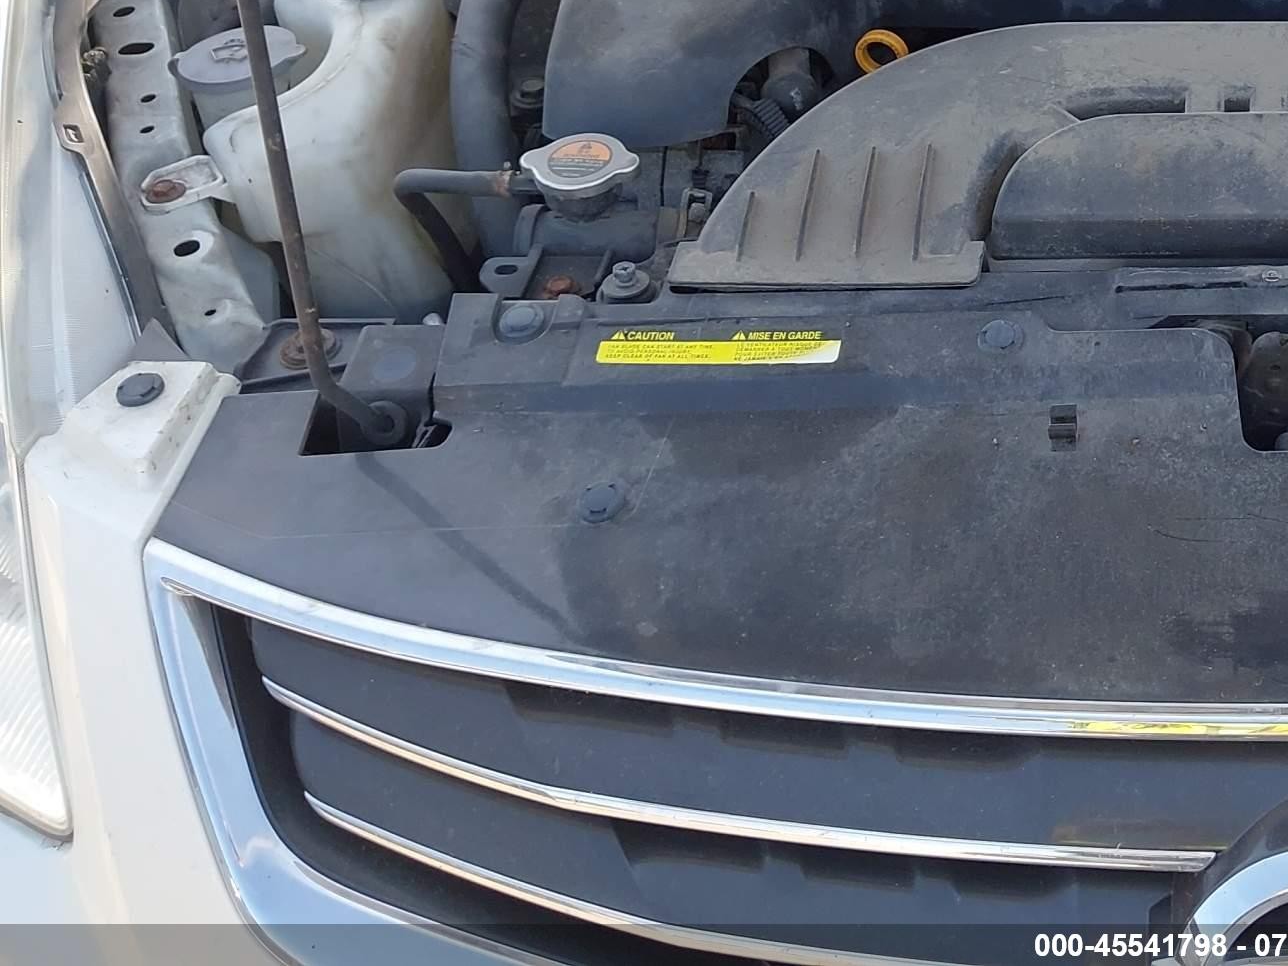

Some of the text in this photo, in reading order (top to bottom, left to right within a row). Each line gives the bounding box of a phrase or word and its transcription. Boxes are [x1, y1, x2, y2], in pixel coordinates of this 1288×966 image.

[627, 331, 675, 340] CAUTION
[747, 331, 823, 340] MISE EN GARDE
